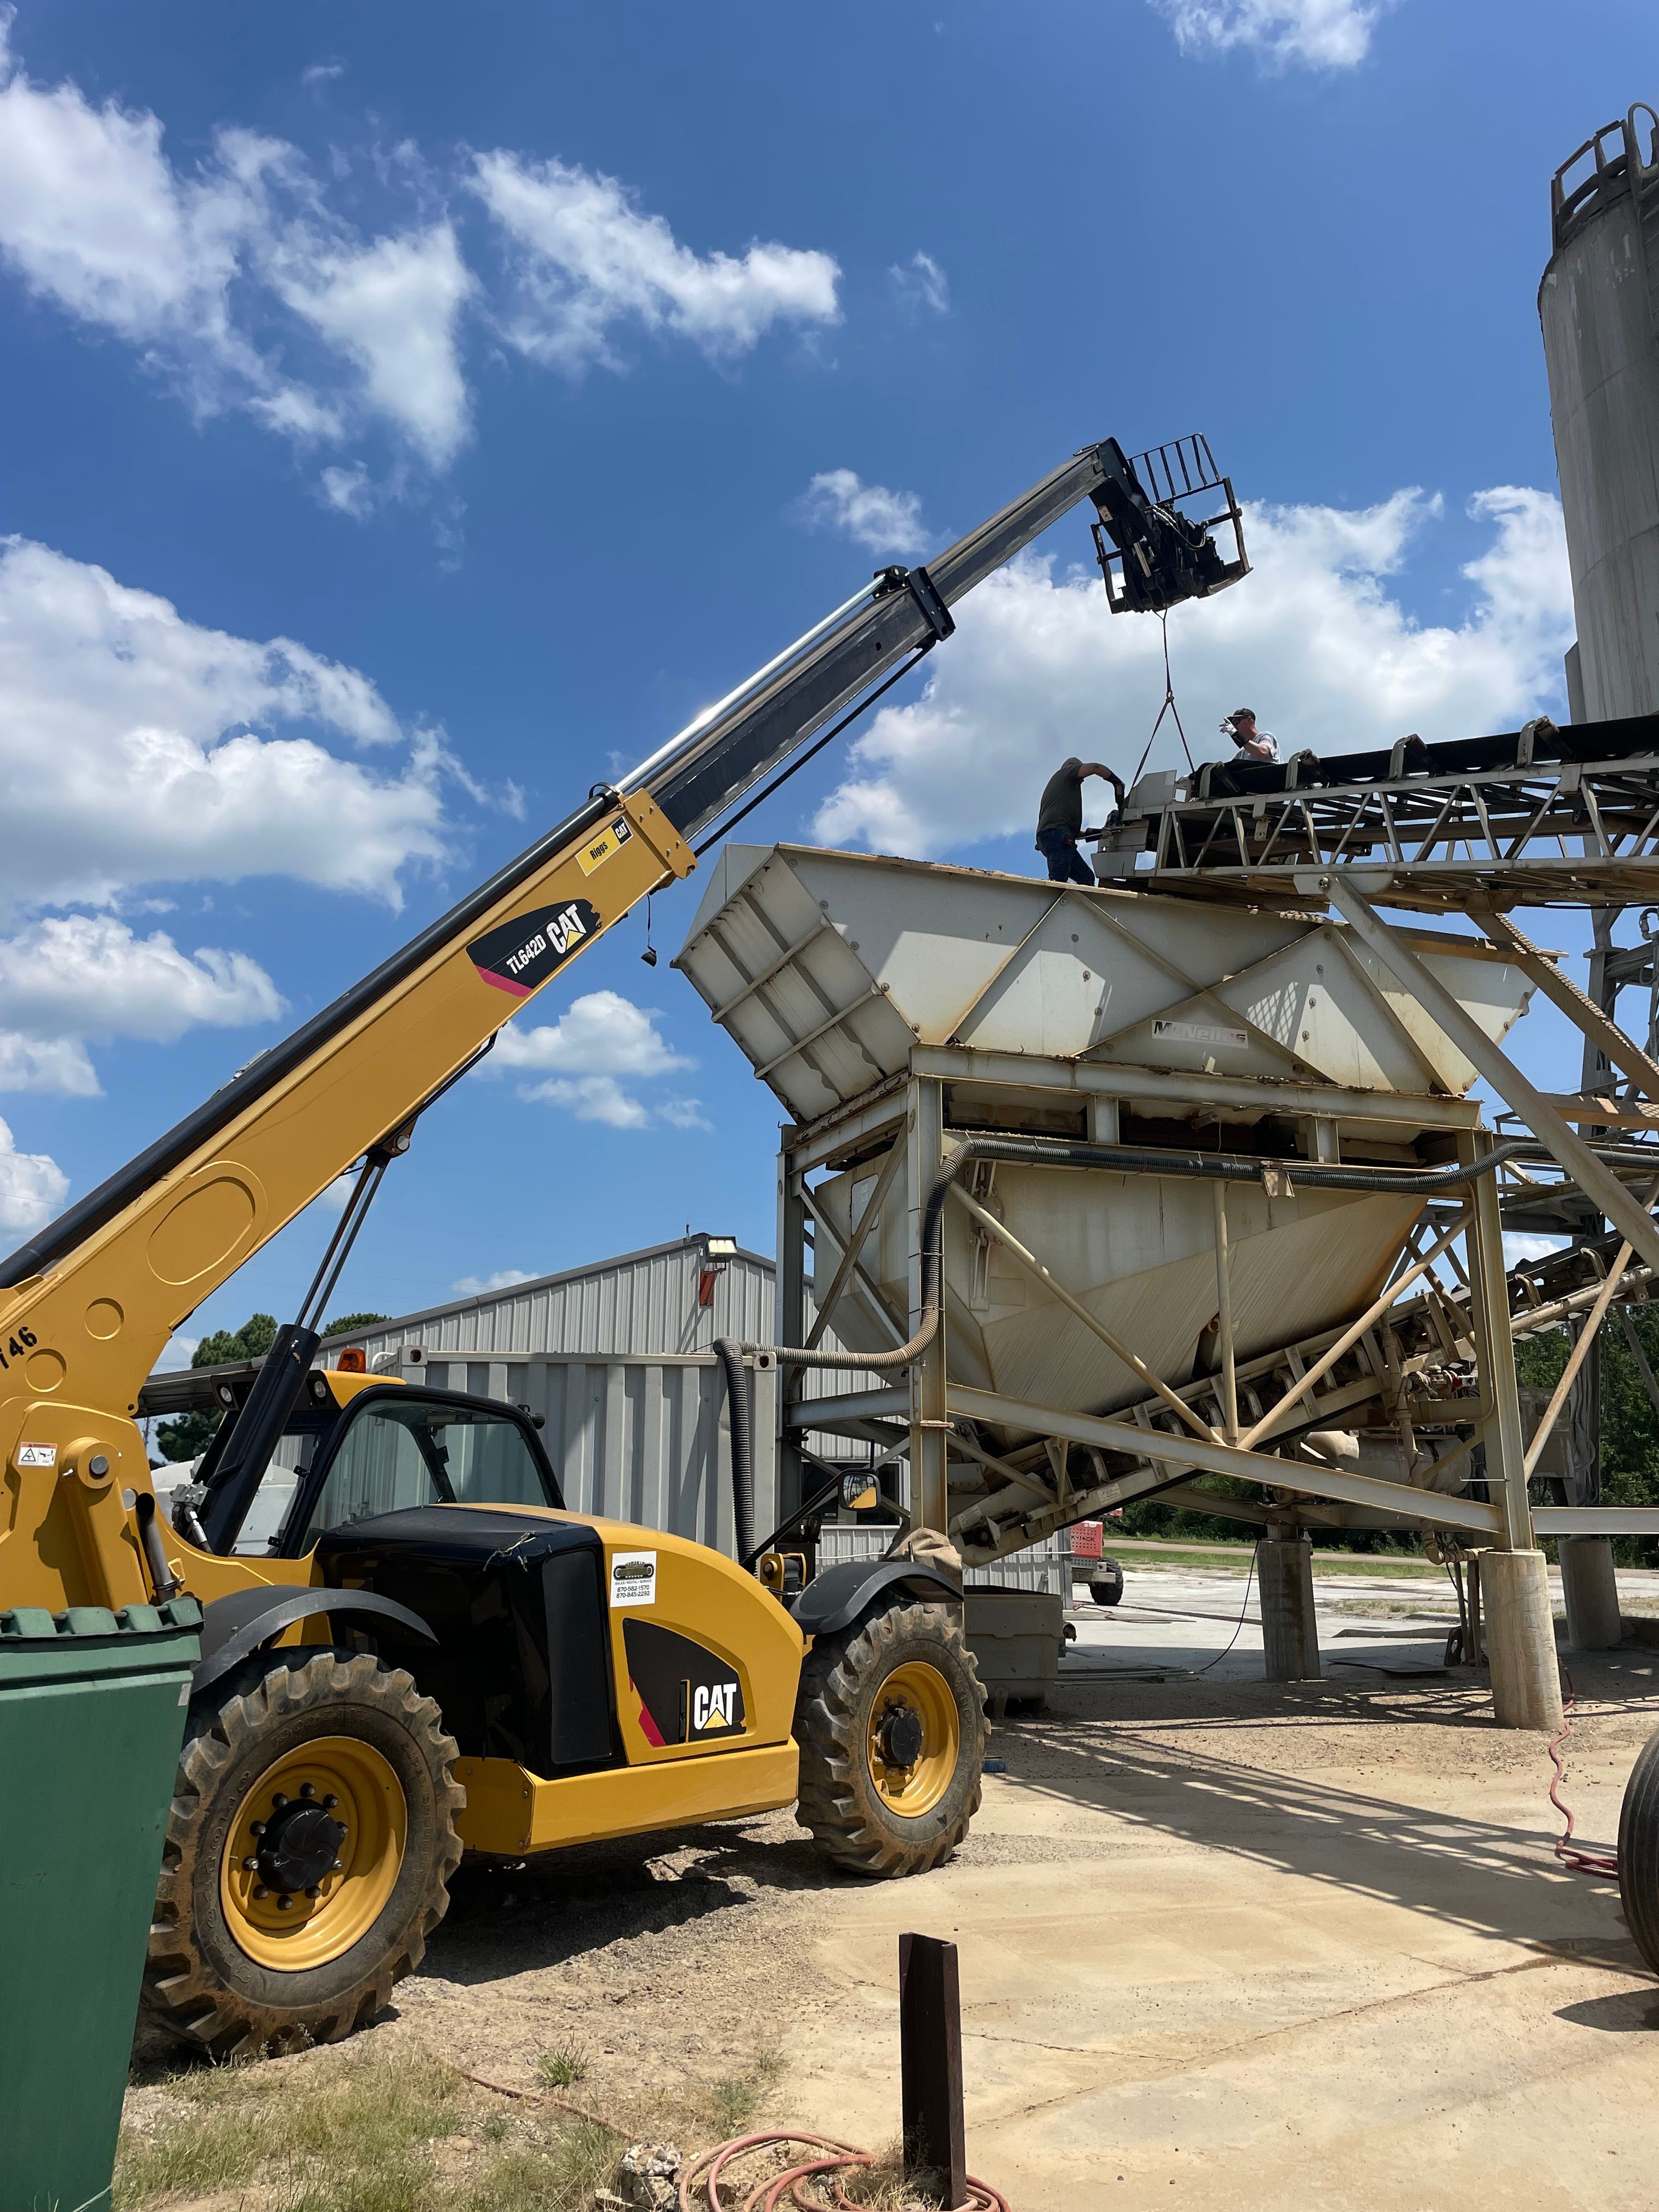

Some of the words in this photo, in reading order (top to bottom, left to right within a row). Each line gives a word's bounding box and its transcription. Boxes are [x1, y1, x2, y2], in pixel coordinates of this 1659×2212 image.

[614, 822, 628, 839] CAT
[589, 841, 608, 861] Riggs
[546, 904, 588, 954] CAT
[506, 934, 546, 974] TL642D
[694, 1683, 737, 1730] CAT
